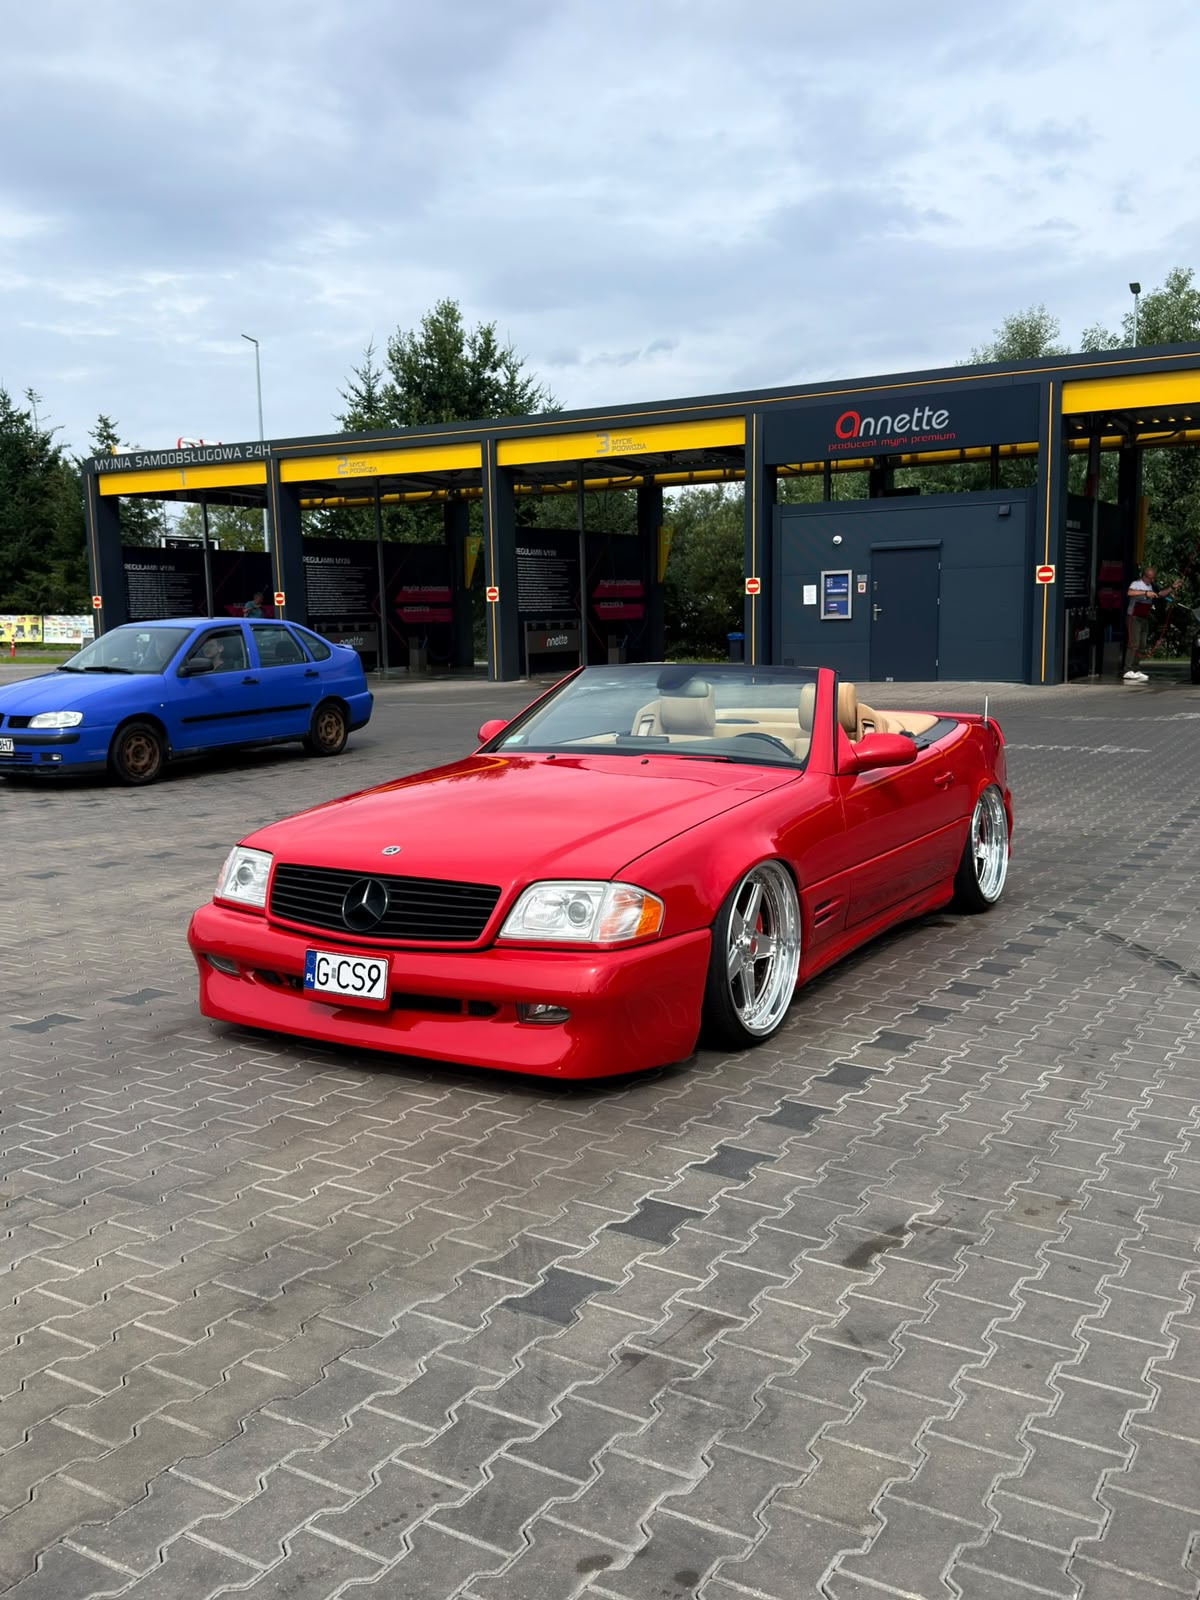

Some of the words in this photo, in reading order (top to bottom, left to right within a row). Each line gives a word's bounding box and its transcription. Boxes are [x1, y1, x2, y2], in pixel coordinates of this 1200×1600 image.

[835, 406, 949, 439] annette
[596, 433, 610, 454] 3
[828, 439, 877, 452] producent
[881, 436, 908, 447] myjni
[911, 432, 956, 445] premium
[94, 457, 132, 471] MYJNIA
[135, 447, 242, 468] SAMOOBSŁUGOWA
[245, 444, 272, 458] 24H
[336, 455, 349, 475] 2
[306, 973, 314, 982] PL
